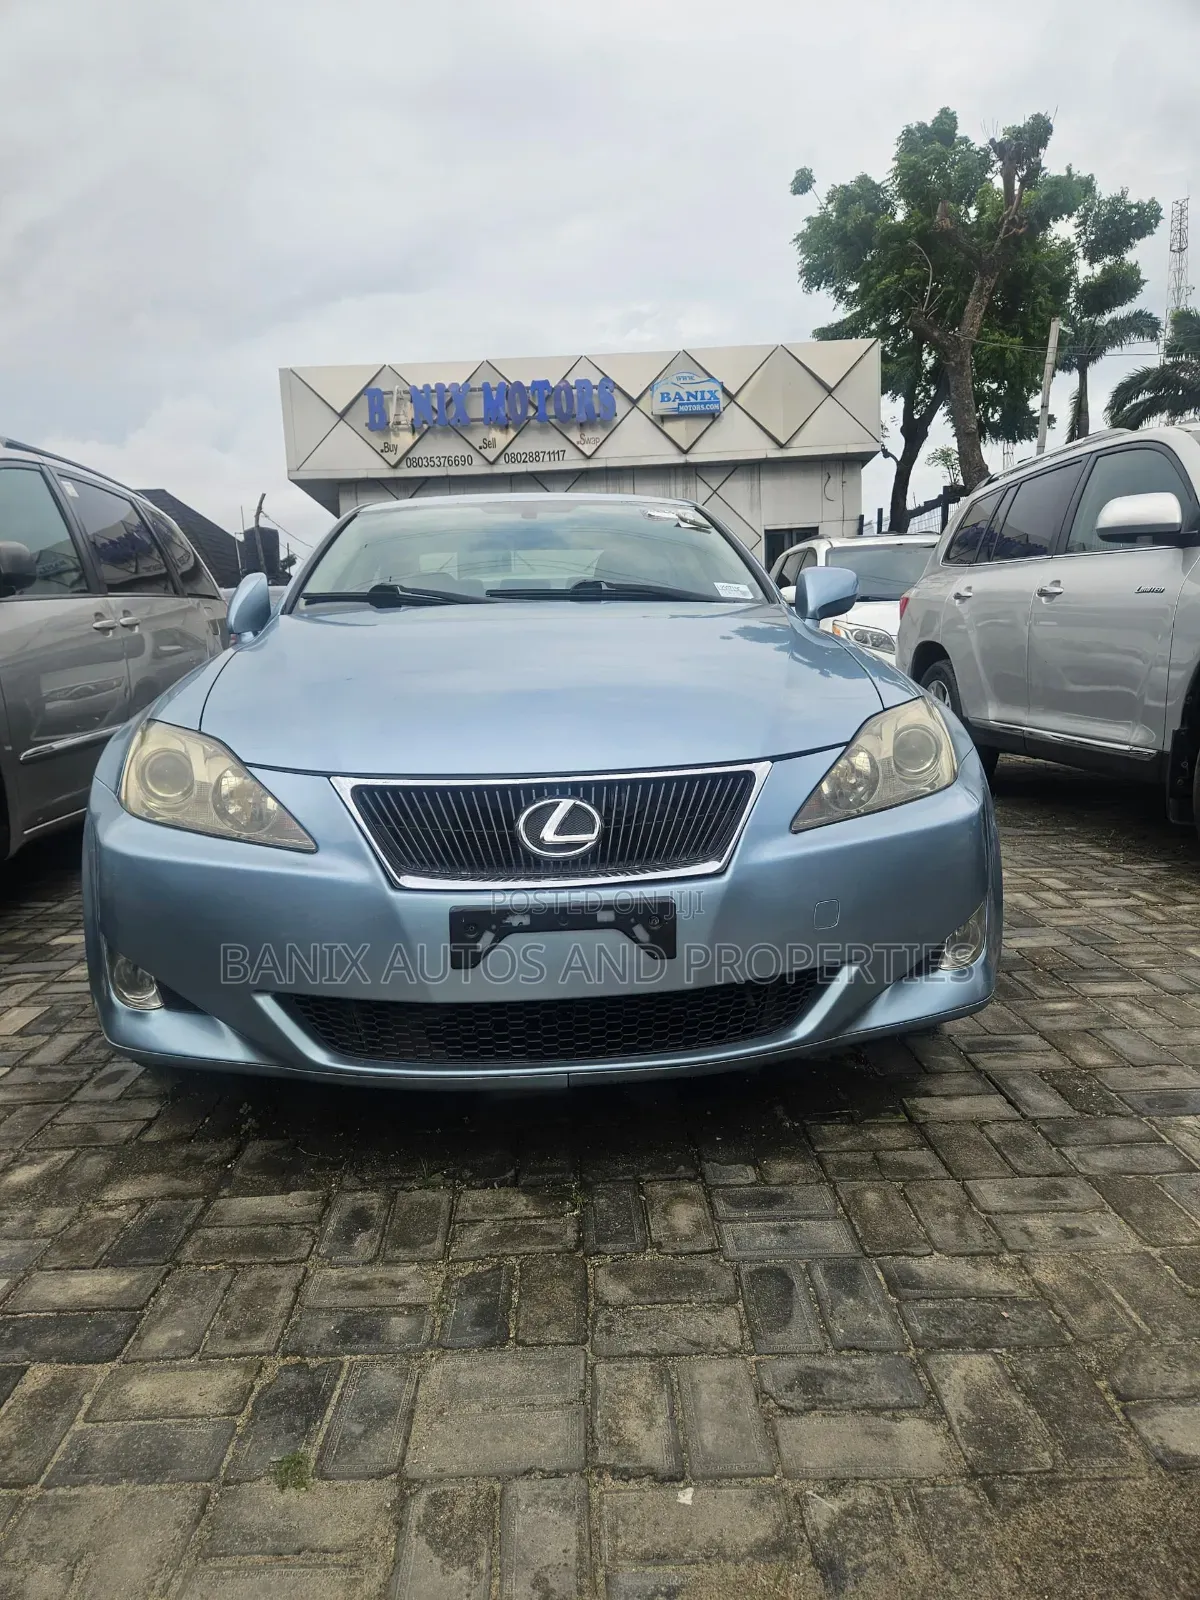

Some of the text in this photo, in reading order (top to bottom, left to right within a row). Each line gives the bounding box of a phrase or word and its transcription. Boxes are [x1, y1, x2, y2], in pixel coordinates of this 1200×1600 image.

[482, 377, 616, 425] MOTORS
[660, 390, 720, 402] BANIX
[678, 403, 719, 412] MOTORS.COM
[405, 454, 473, 468] 08035376690
[503, 449, 566, 464] 08028871117
